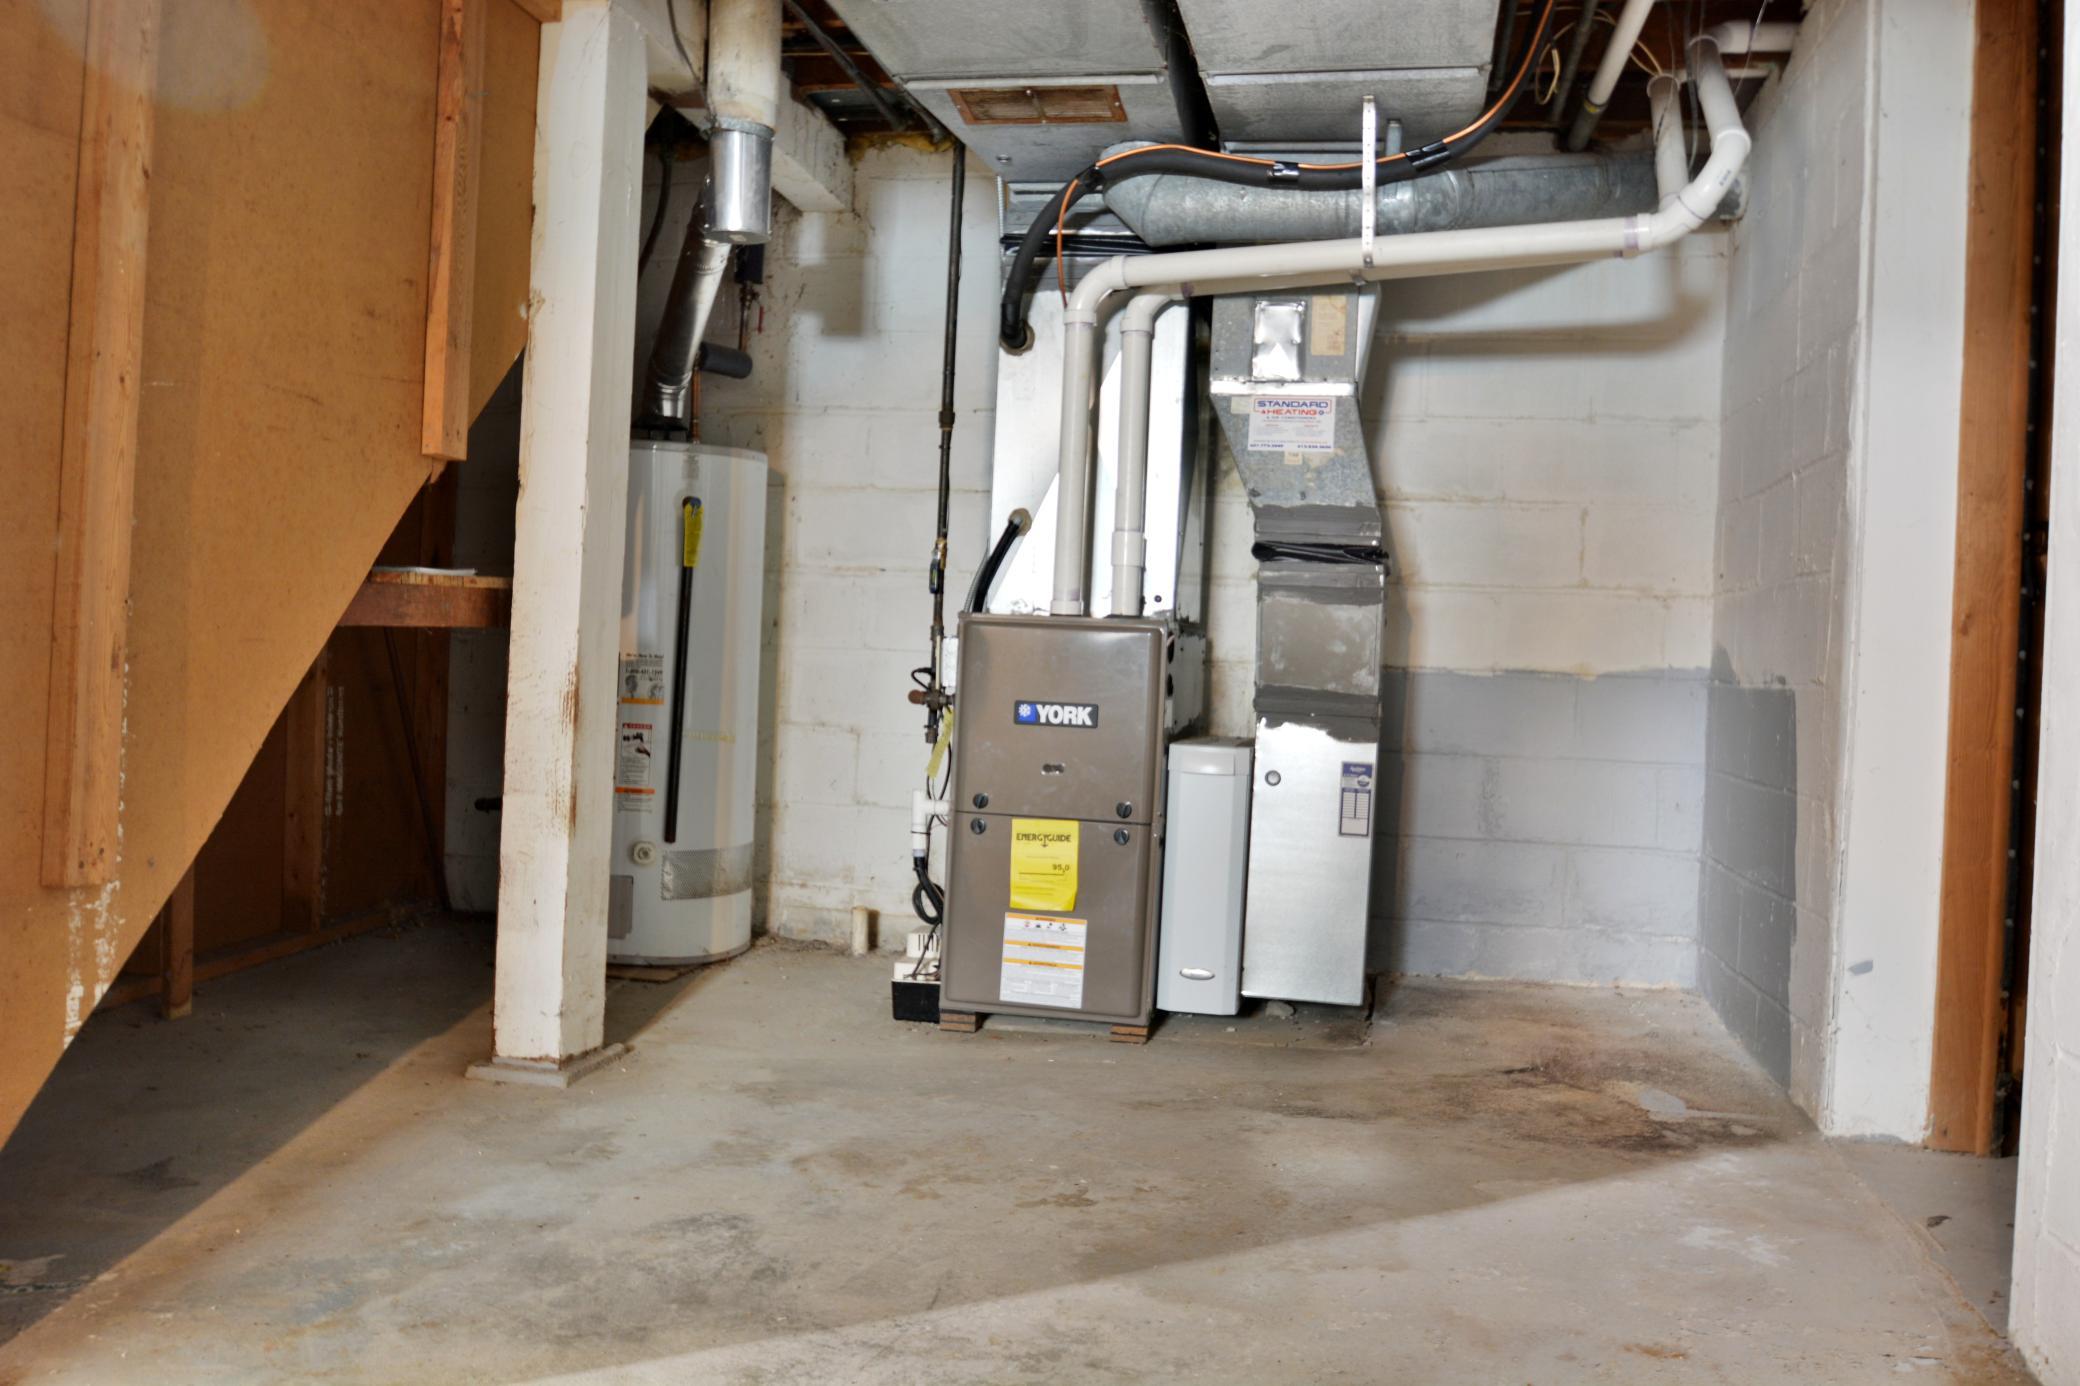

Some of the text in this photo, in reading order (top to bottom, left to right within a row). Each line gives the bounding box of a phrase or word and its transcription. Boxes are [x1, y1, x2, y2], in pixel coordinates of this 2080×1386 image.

[1257, 400, 1329, 409] STANDARD
[1266, 408, 1318, 416] HEATING
[1035, 703, 1093, 726] YORK
